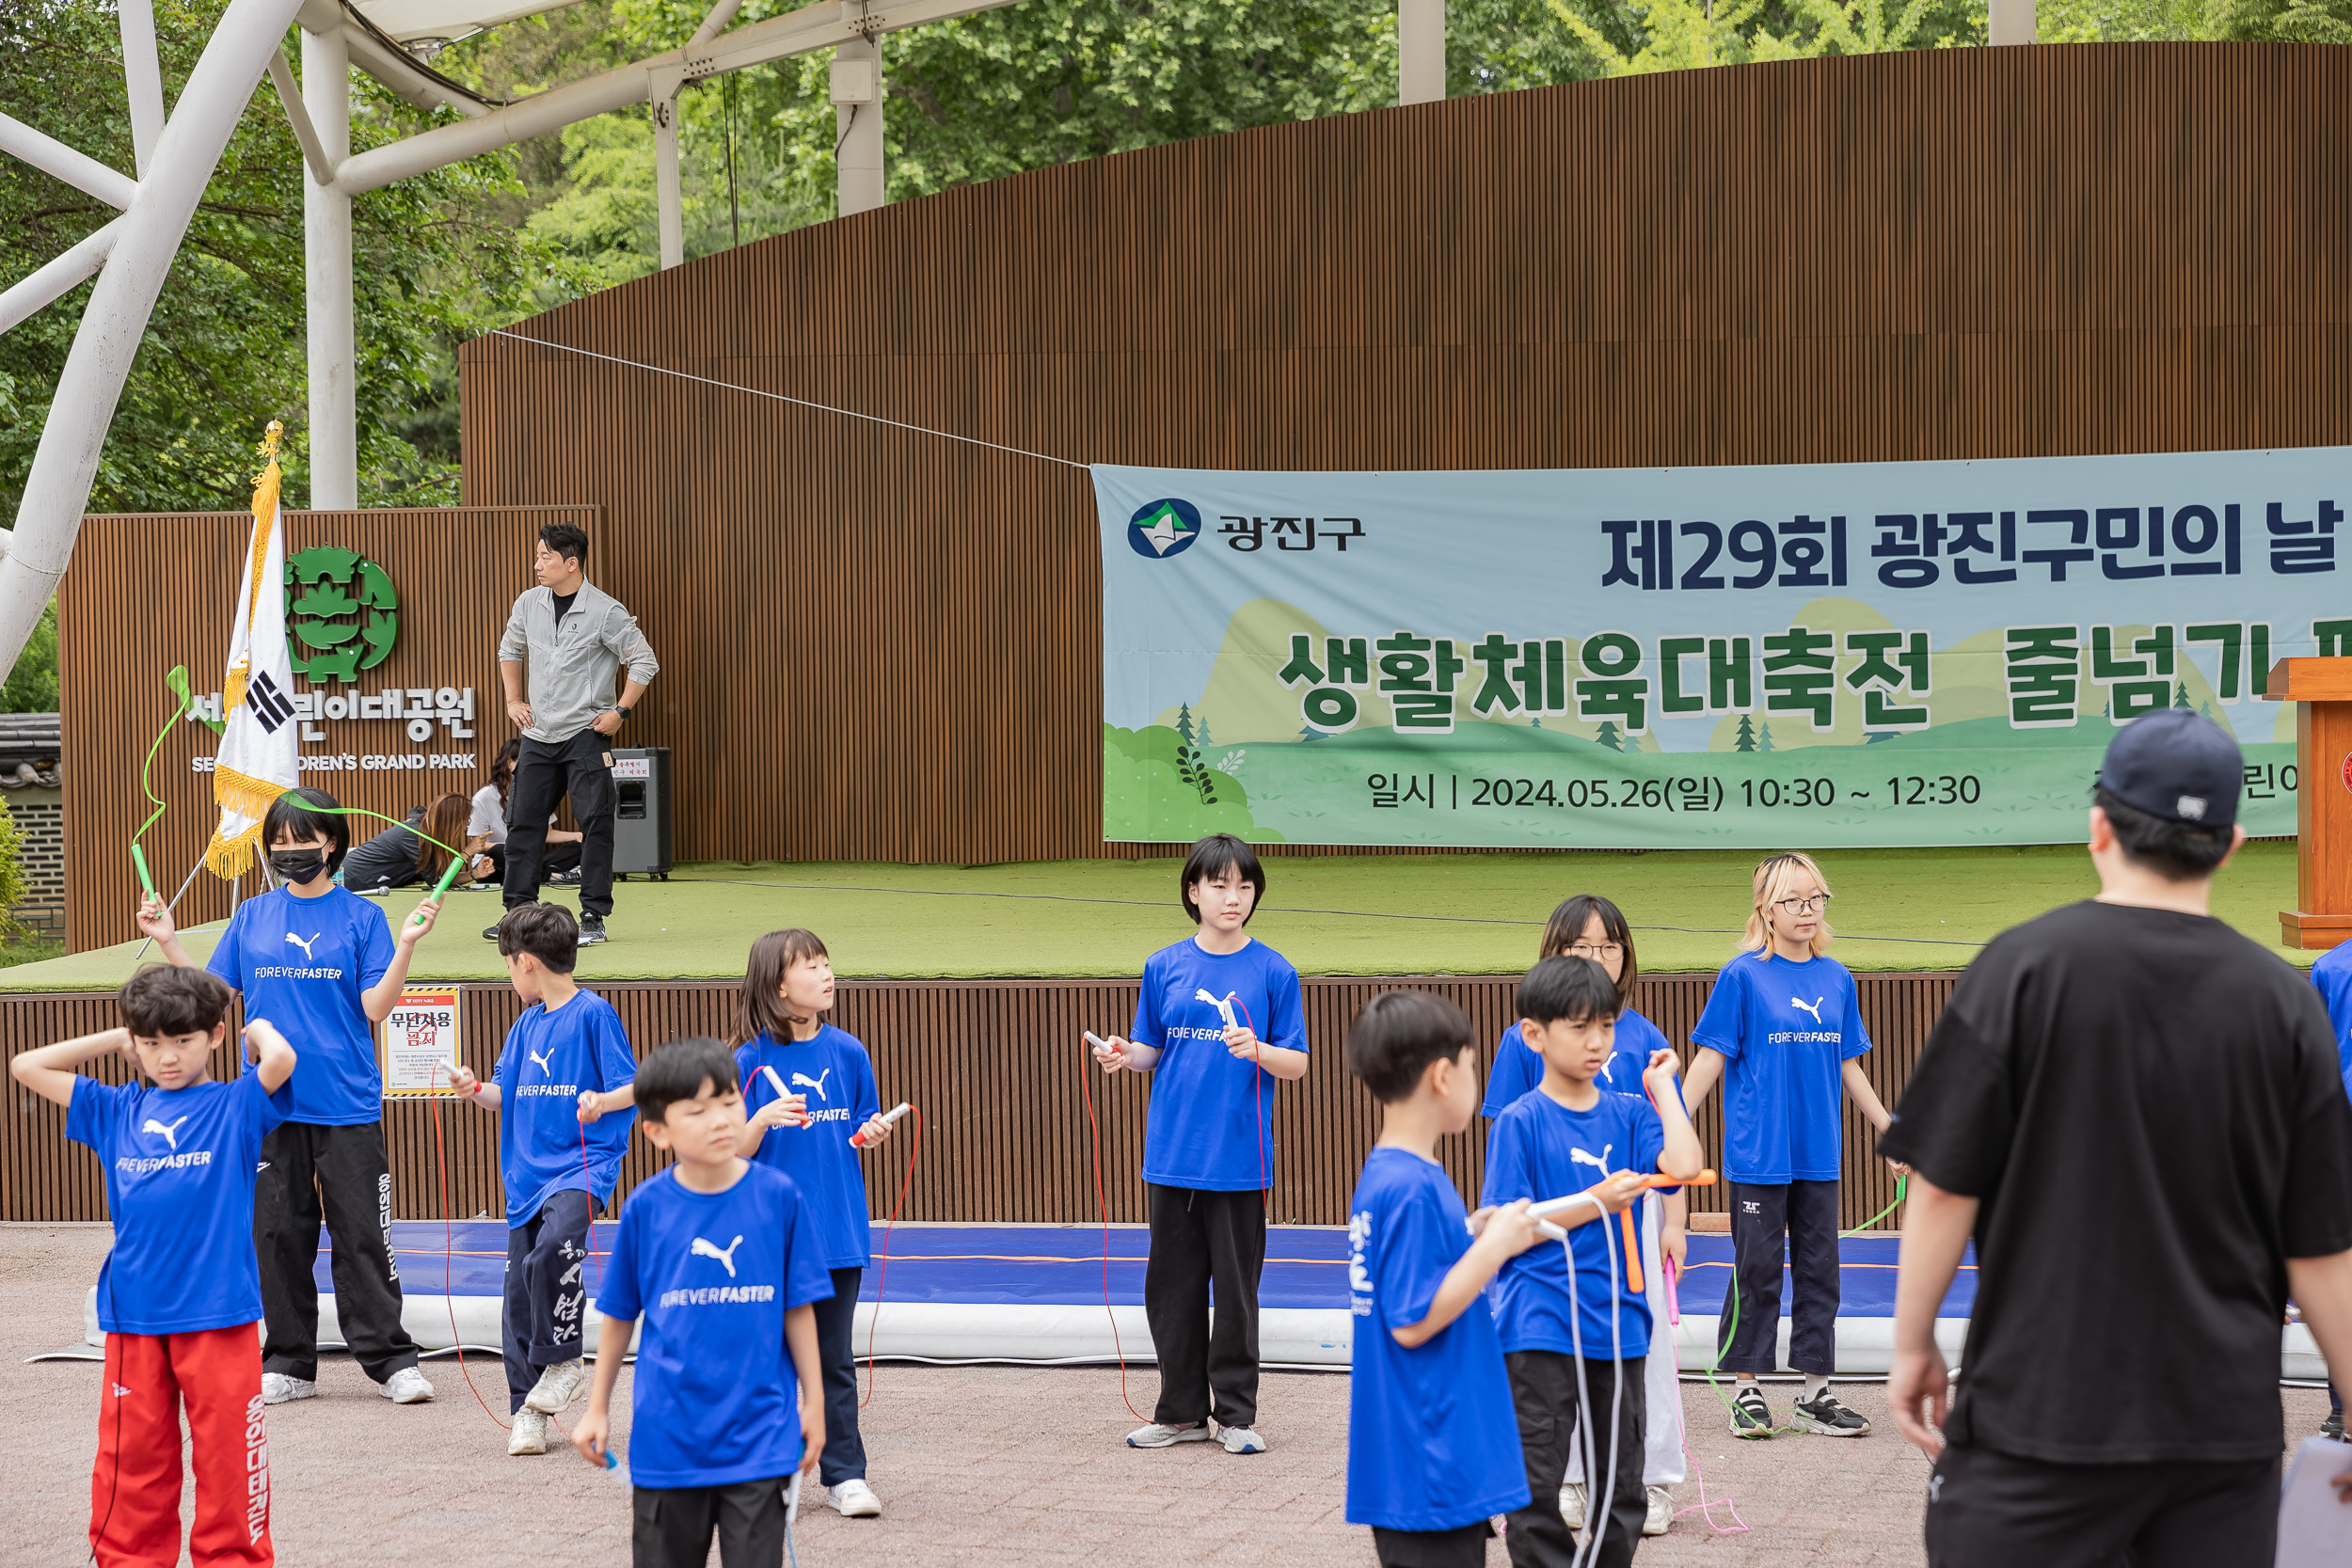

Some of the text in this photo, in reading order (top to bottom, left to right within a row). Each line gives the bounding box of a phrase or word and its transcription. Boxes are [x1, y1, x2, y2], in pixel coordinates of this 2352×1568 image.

[1217, 515, 1366, 552] 광진구
[1600, 499, 2344, 590] 제29회 광진구민의 날
[1278, 621, 2273, 736] 생활체육대축전 줄넘기
[360, 754, 426, 770] GRAND
[429, 753, 477, 769] PARK
[1367, 773, 1436, 809] 일시
[1471, 775, 1724, 813] 2024.05.26(일)
[1740, 778, 1836, 806] 10:30
[1886, 775, 1981, 805] 12:30
[255, 966, 342, 980] FOREVERFASTER
[390, 1012, 452, 1028] 무단사용
[406, 1031, 437, 1047] 금지
